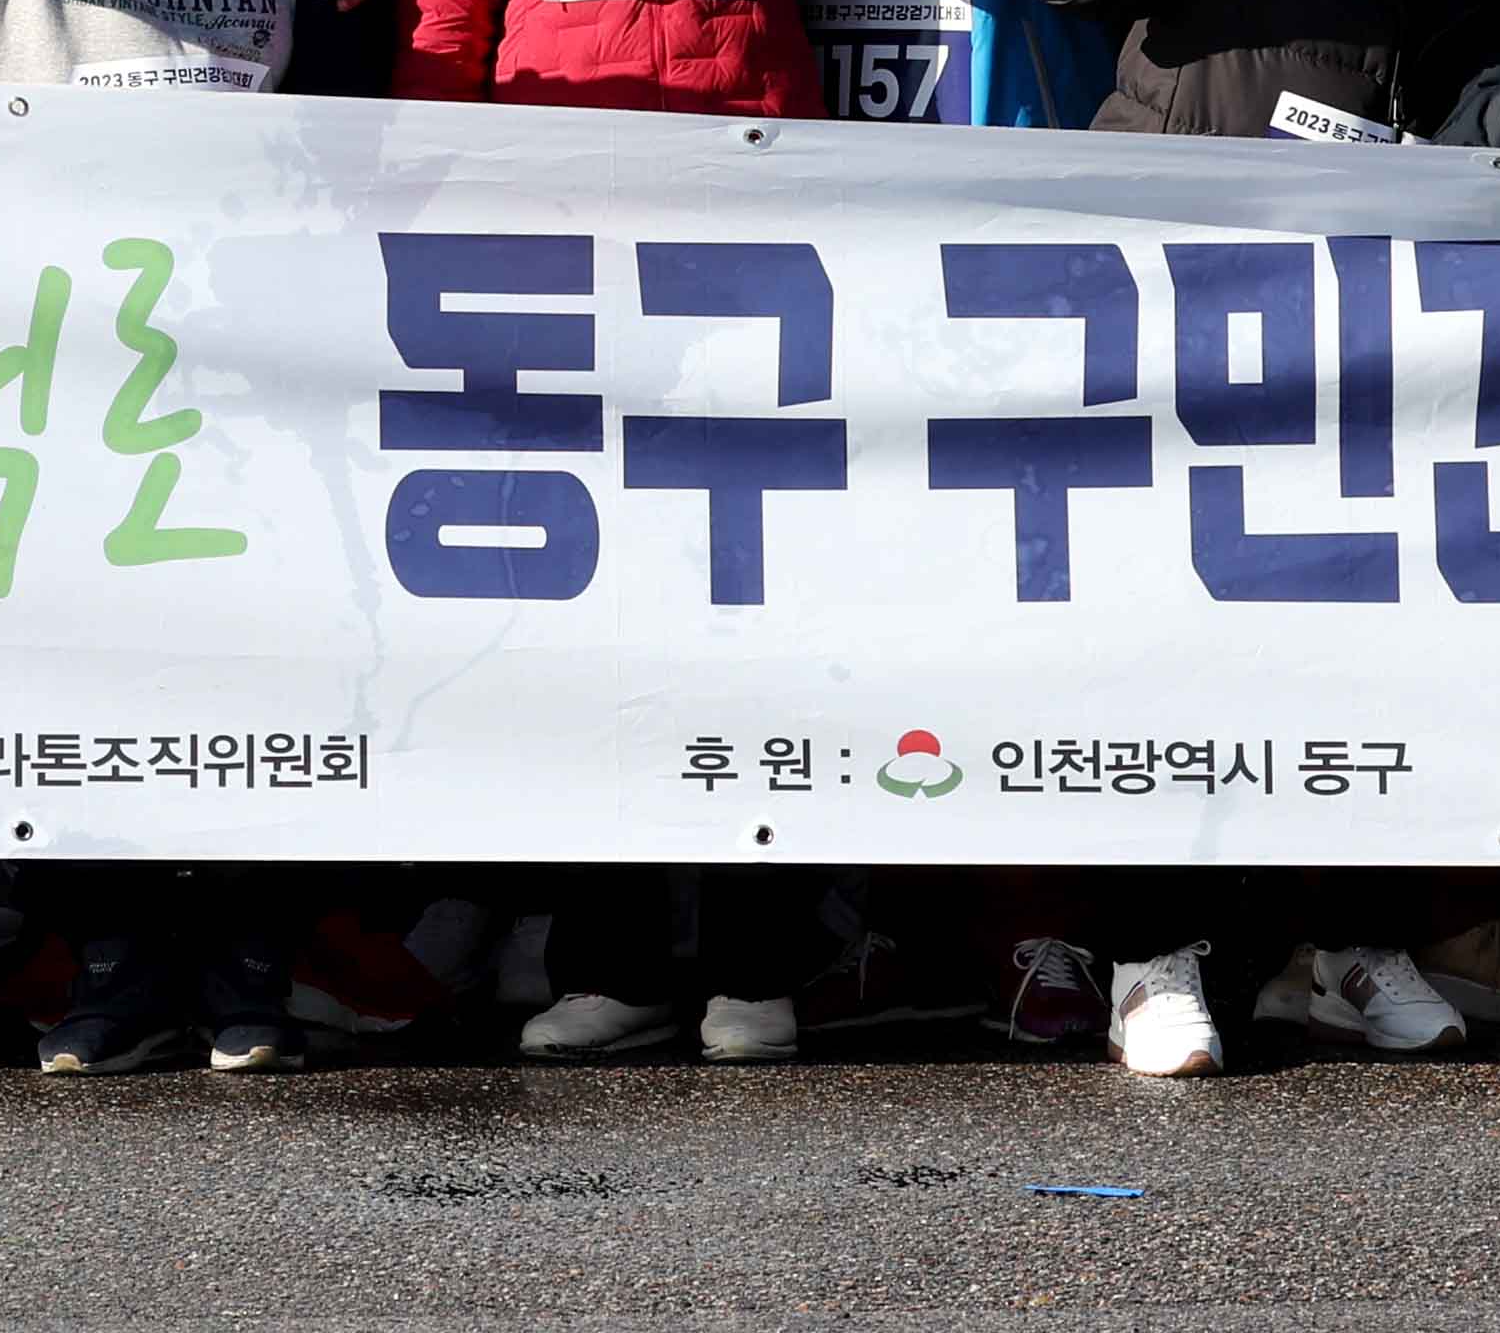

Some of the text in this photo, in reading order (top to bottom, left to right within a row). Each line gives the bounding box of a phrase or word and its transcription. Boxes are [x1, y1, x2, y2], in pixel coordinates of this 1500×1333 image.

[854, 4, 967, 23] 구민건강걷기대회
[127, 71, 158, 89] 동구
[831, 44, 950, 118] 157
[1285, 106, 1330, 134] 2023
[377, 232, 848, 605] 동구
[991, 737, 1274, 795] 인천광역시
[1298, 739, 1414, 795] 동구
